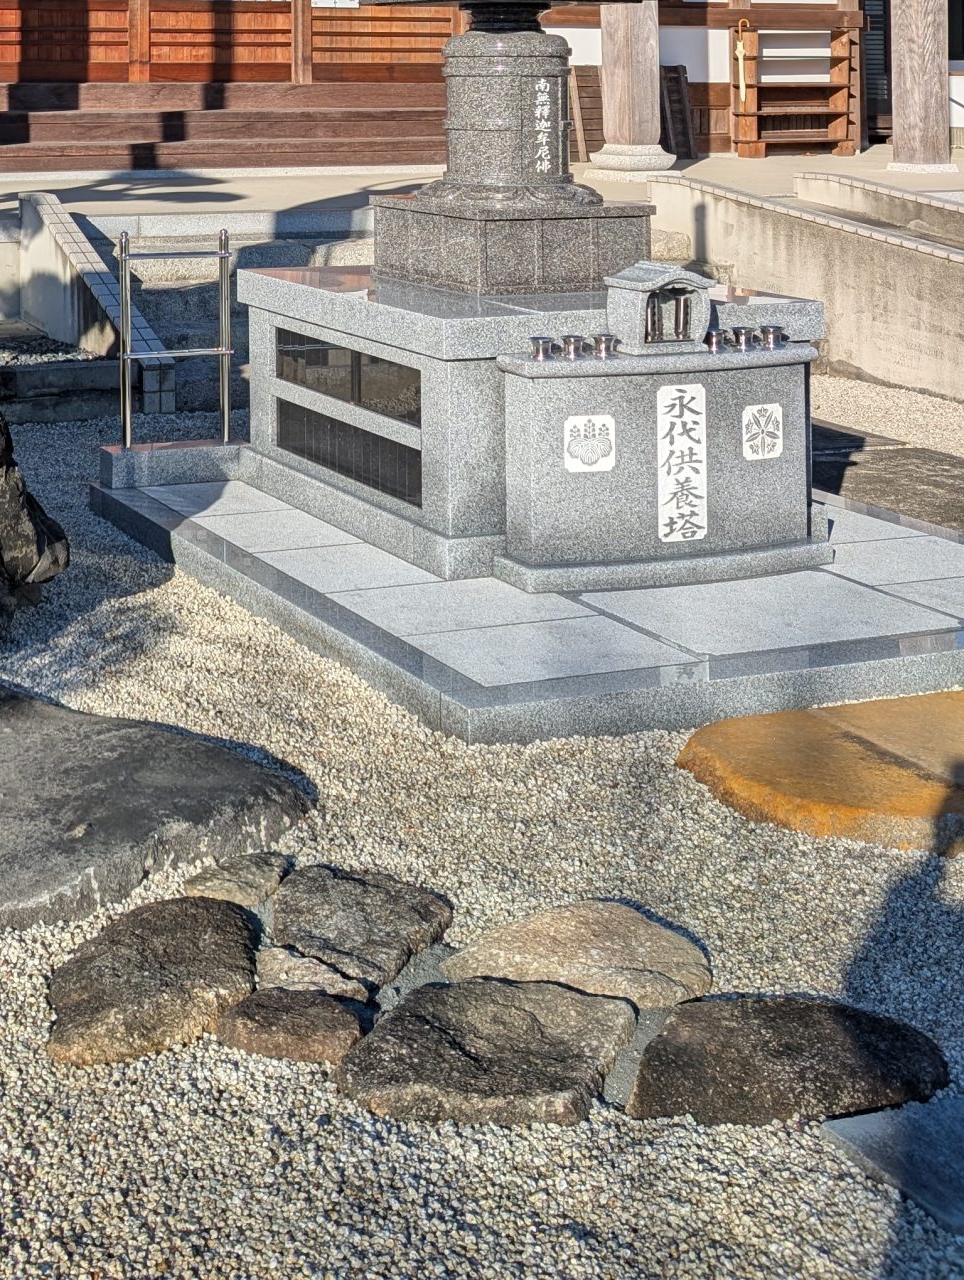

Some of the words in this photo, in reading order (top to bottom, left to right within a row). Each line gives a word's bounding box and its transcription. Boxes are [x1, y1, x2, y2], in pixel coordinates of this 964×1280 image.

[660, 388, 705, 539] 永代供養塔
